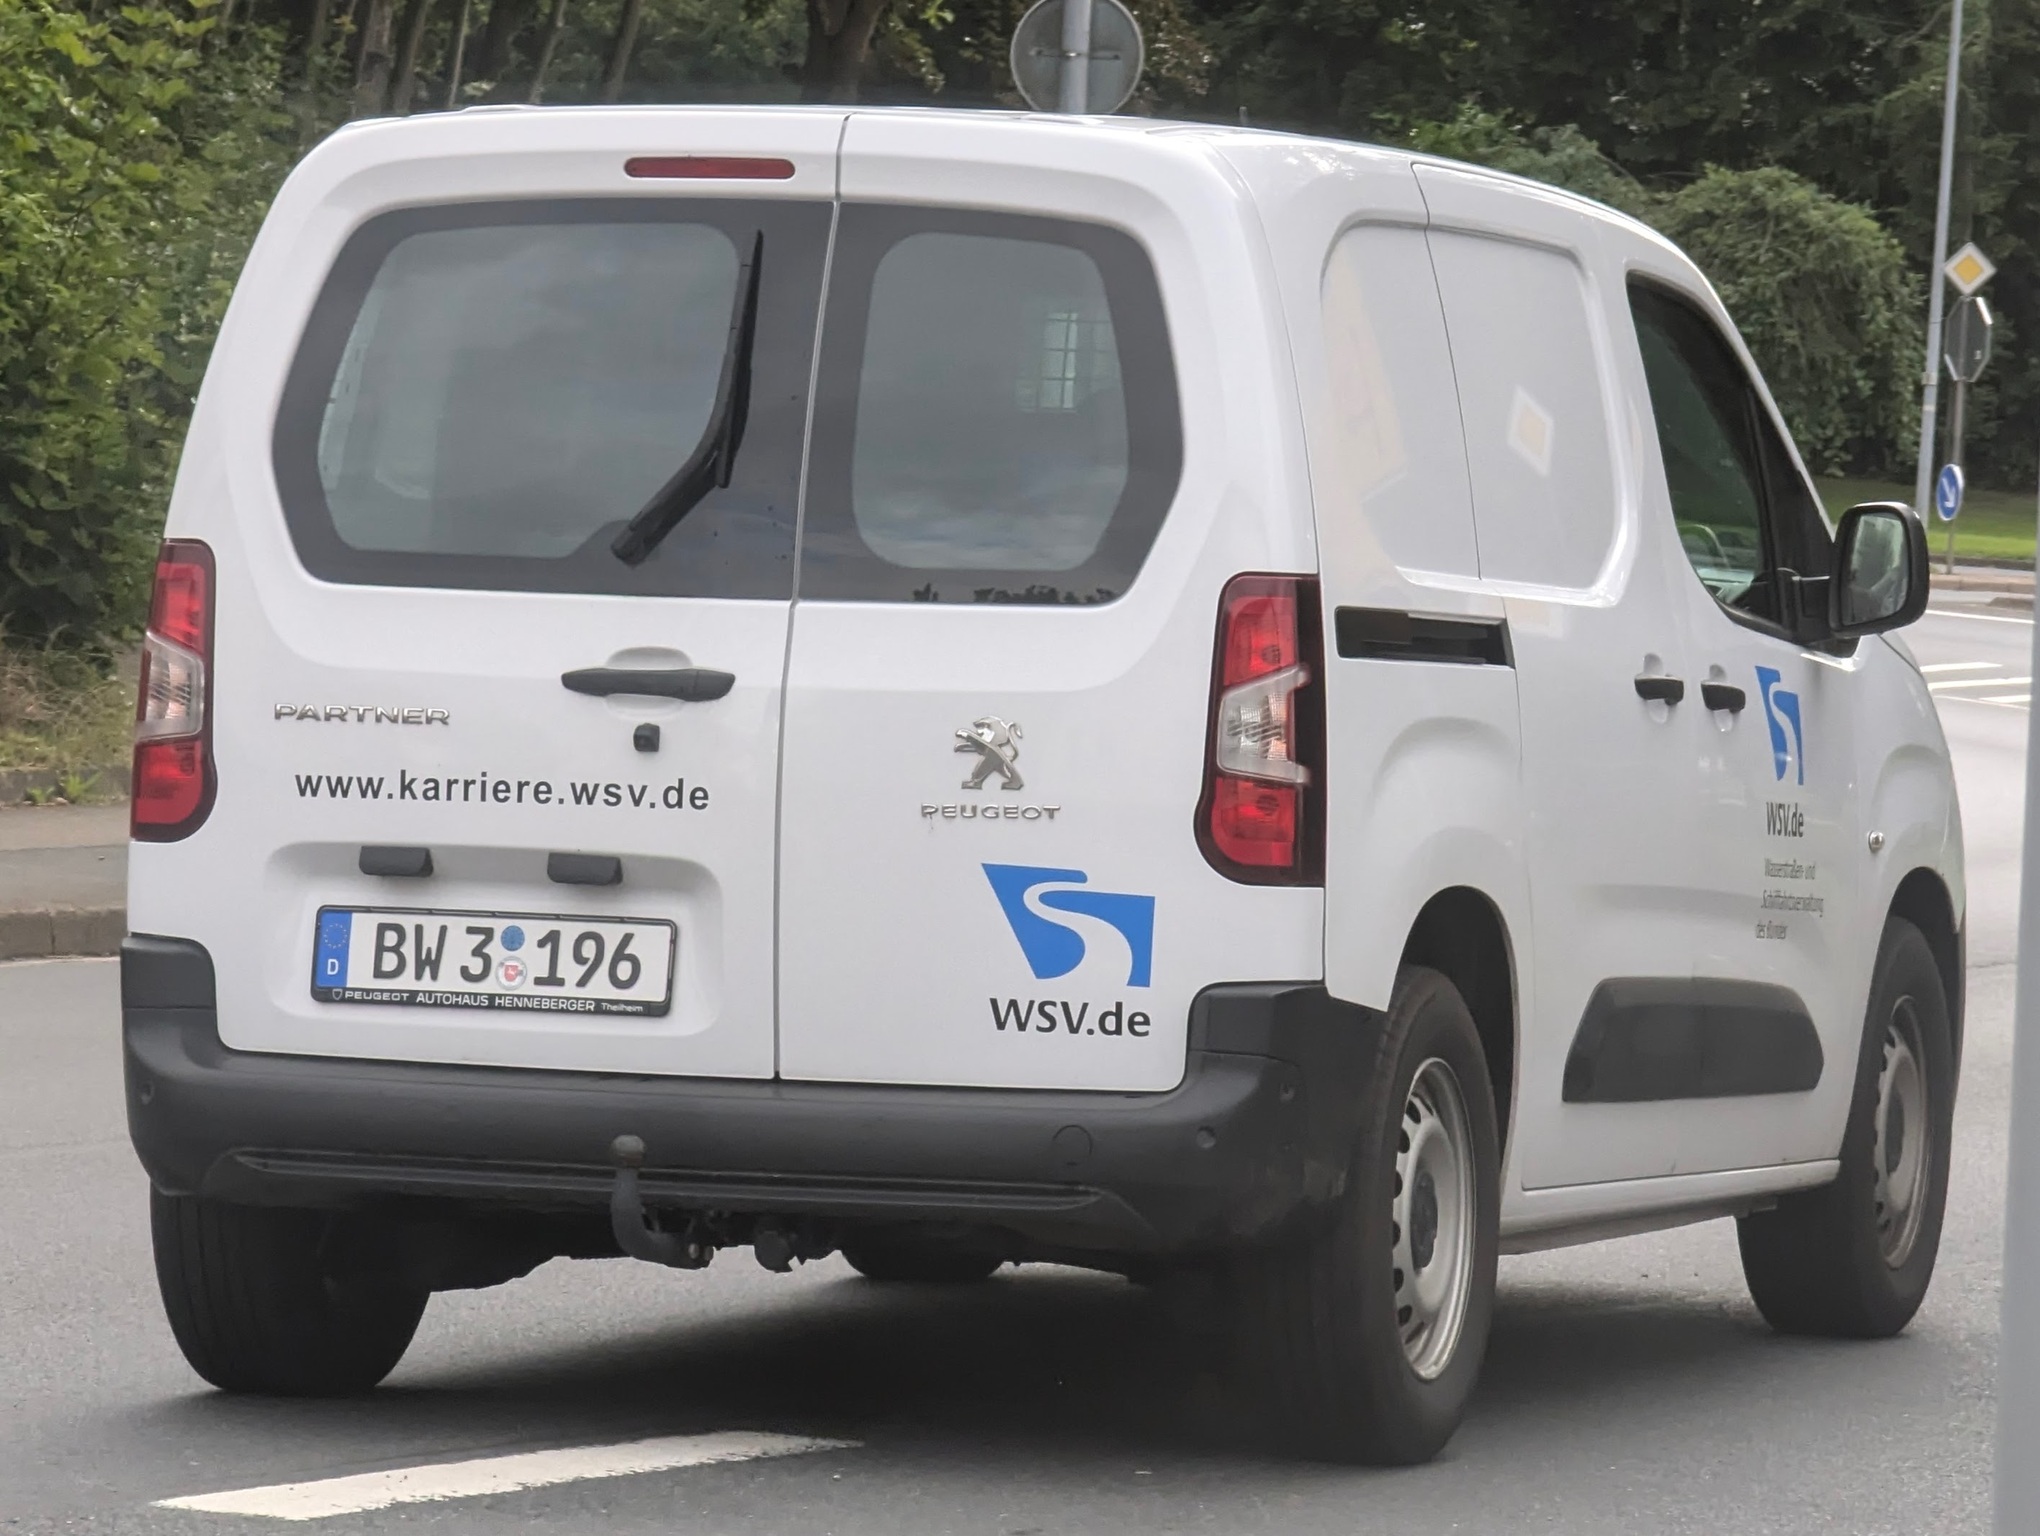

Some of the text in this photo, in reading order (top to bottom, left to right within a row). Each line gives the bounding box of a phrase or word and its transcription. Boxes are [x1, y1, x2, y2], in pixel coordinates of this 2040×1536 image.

[273, 702, 451, 726] PARTNER
[294, 769, 710, 811] www.karriere.wsv.de
[920, 802, 1062, 820] PEUGEOT
[1765, 801, 1804, 838] WSV.de
[326, 958, 339, 976] D
[372, 921, 643, 990] BW 3 196
[344, 990, 410, 1002] PEUGEOT
[415, 991, 490, 1007] AUTOHAUS
[494, 997, 596, 1013] HENNEBERGER
[988, 997, 1152, 1038] WSV.de
